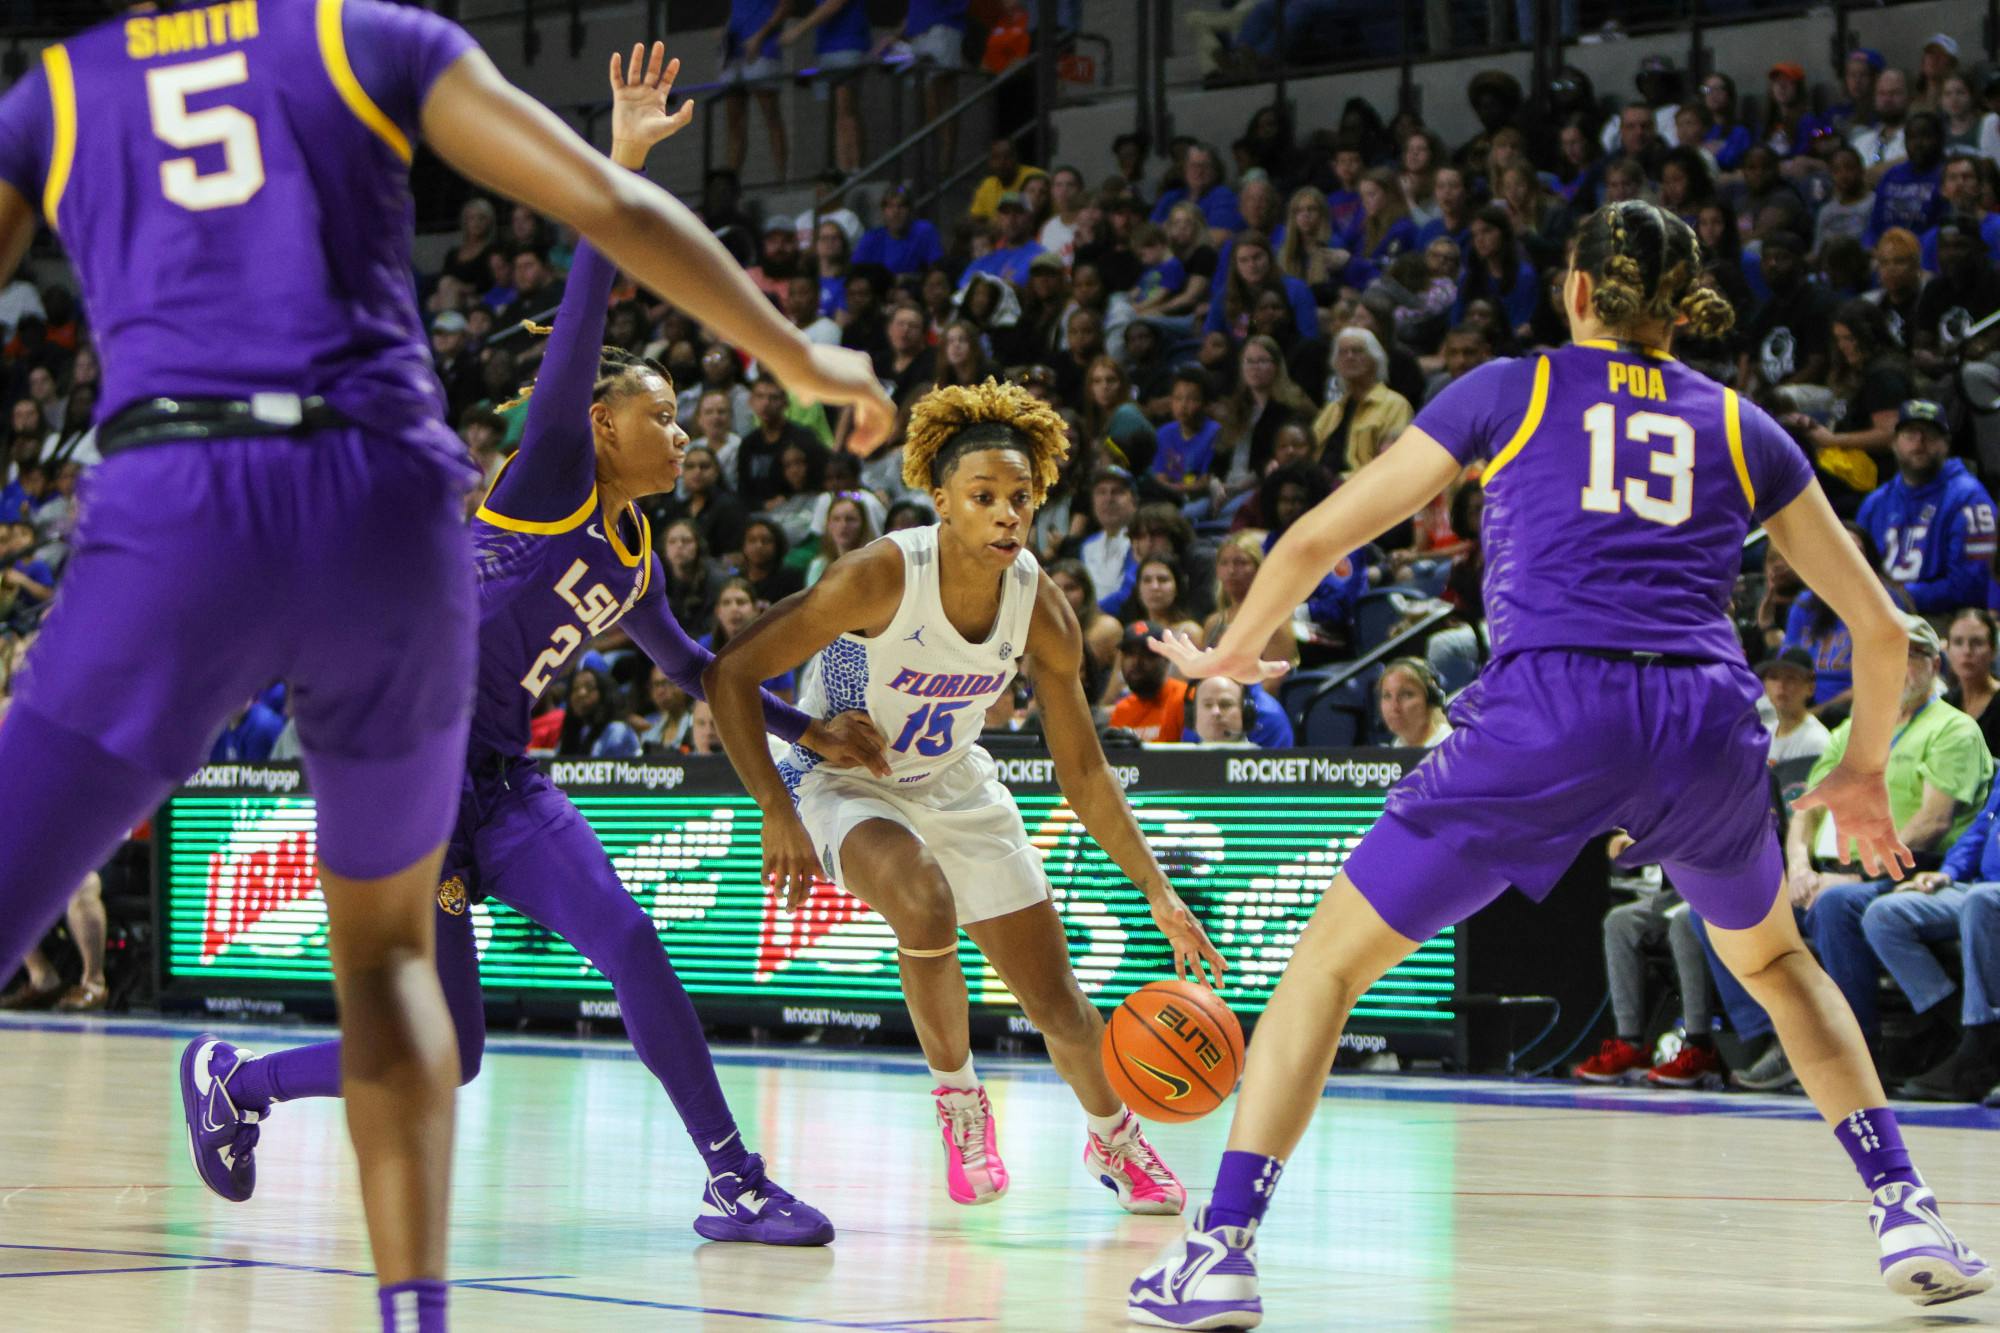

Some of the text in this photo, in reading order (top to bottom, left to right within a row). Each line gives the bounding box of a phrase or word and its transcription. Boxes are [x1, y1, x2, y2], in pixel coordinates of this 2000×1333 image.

[125, 0, 260, 60] SMITH
[145, 50, 266, 212] 5
[1608, 360, 1668, 403] POA
[1581, 401, 1696, 527] 13
[1883, 526, 1924, 582] 15
[553, 557, 624, 637] LSU
[886, 667, 1007, 698] FLORIDA
[890, 700, 975, 757] 15
[241, 765, 300, 792] Mortgage
[551, 762, 684, 789] ROCKET Mortgage
[995, 759, 1055, 783] OCKET
[1226, 758, 1402, 788] ROCKET Mortgage
[580, 1000, 621, 1018] ROCKE
[783, 1007, 881, 1030] ROCKET Mortgage
[1154, 1003, 1224, 1072] ELITE
[1338, 1033, 1387, 1053] ortgage
